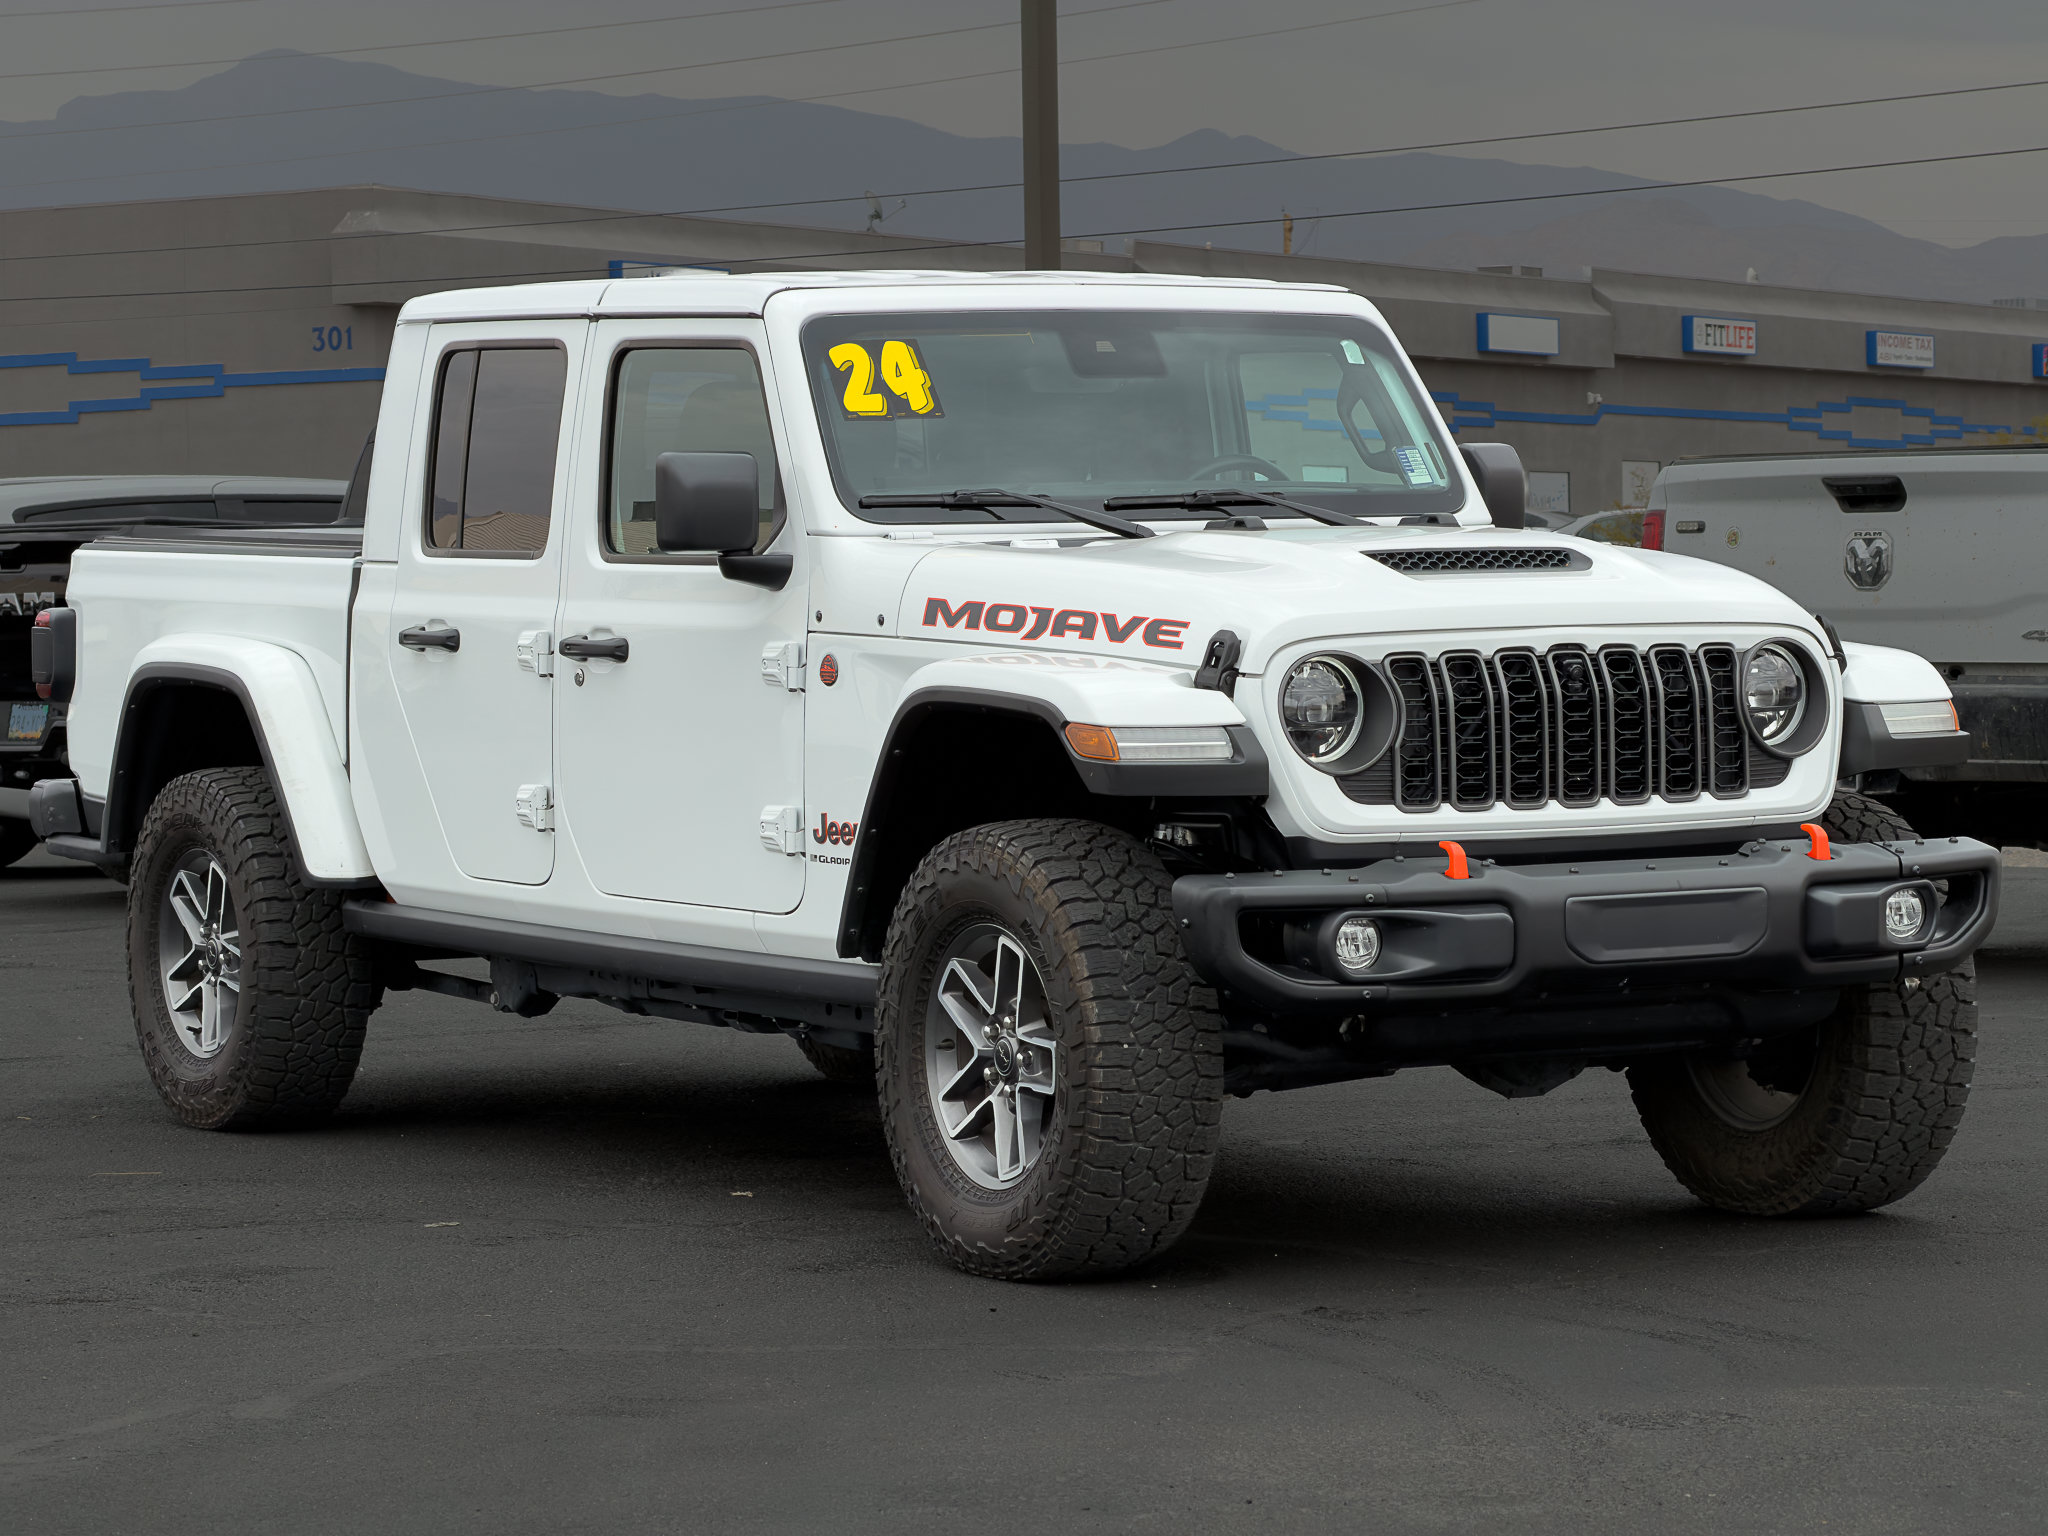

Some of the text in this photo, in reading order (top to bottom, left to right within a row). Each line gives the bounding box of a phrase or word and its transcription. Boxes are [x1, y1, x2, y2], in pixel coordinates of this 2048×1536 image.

[312, 326, 352, 352] 301
[1878, 335, 1932, 350] INCOME TAX
[828, 340, 935, 416] 24
[922, 597, 1191, 650] MOJAVE
